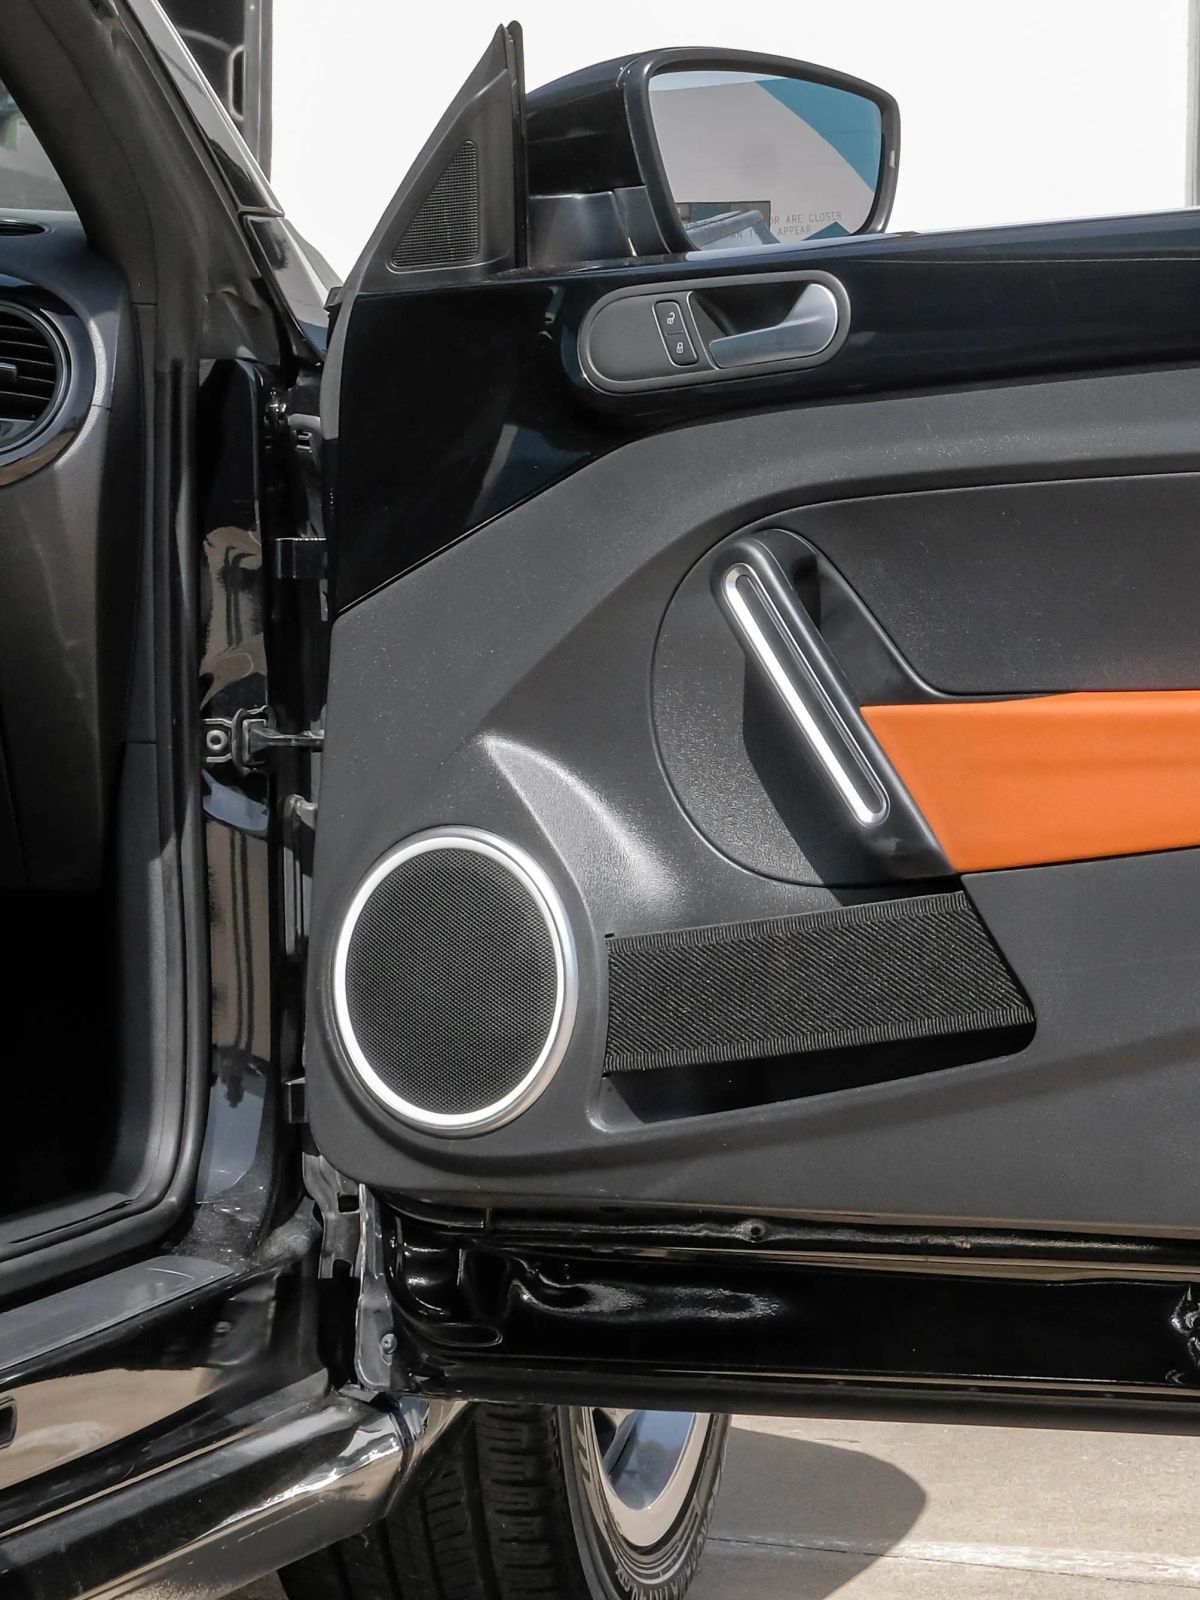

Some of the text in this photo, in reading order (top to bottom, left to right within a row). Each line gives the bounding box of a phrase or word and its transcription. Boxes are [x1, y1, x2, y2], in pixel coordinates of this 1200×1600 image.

[786, 214, 803, 224] ARE
[808, 211, 842, 223] CLOSER
[777, 225, 811, 236] APPEAR
